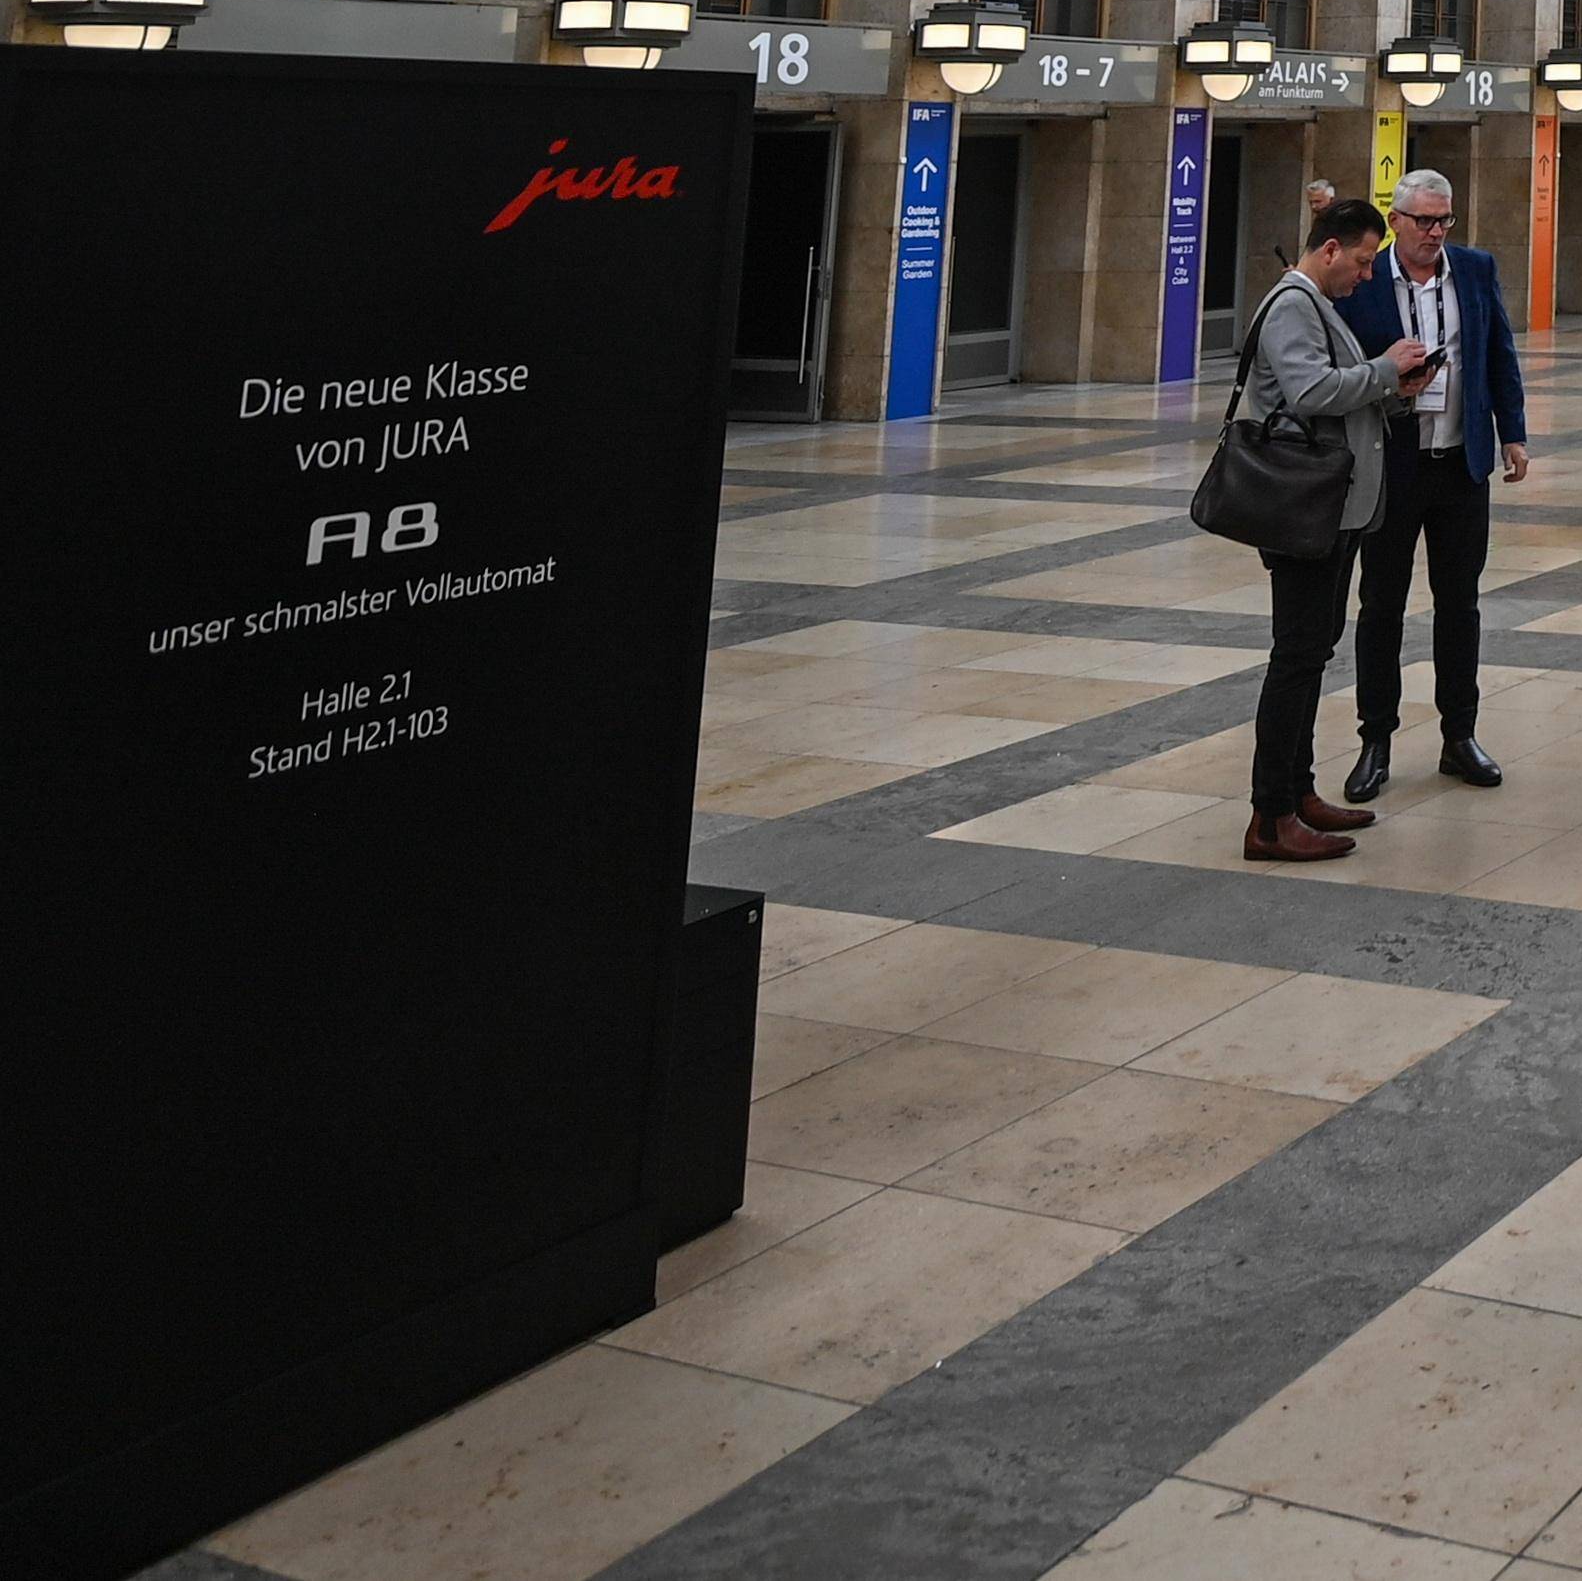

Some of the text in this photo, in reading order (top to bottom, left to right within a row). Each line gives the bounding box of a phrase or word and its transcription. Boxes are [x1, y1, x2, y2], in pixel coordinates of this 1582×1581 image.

[749, 33, 810, 85] 18
[1038, 55, 1067, 86] 18
[1098, 57, 1115, 89] 7
[1259, 85, 1324, 99] am Funkturm
[1465, 70, 1494, 106] 18
[912, 109, 930, 121] IFA
[1177, 114, 1190, 124] IFA
[483, 138, 680, 234] jura
[902, 217, 934, 229] Cooking
[907, 206, 937, 215] Outdoor
[901, 227, 940, 239] Gardening
[902, 259, 935, 269] Summer
[902, 270, 933, 280] Garden
[239, 360, 530, 418] Die neue Klasse
[294, 416, 470, 474] von JURA
[304, 501, 439, 565] A8
[148, 557, 556, 654] unser schmalster Vollautomat
[301, 671, 412, 722] Halle 2.1
[248, 706, 449, 779] Stand H2.1-103
